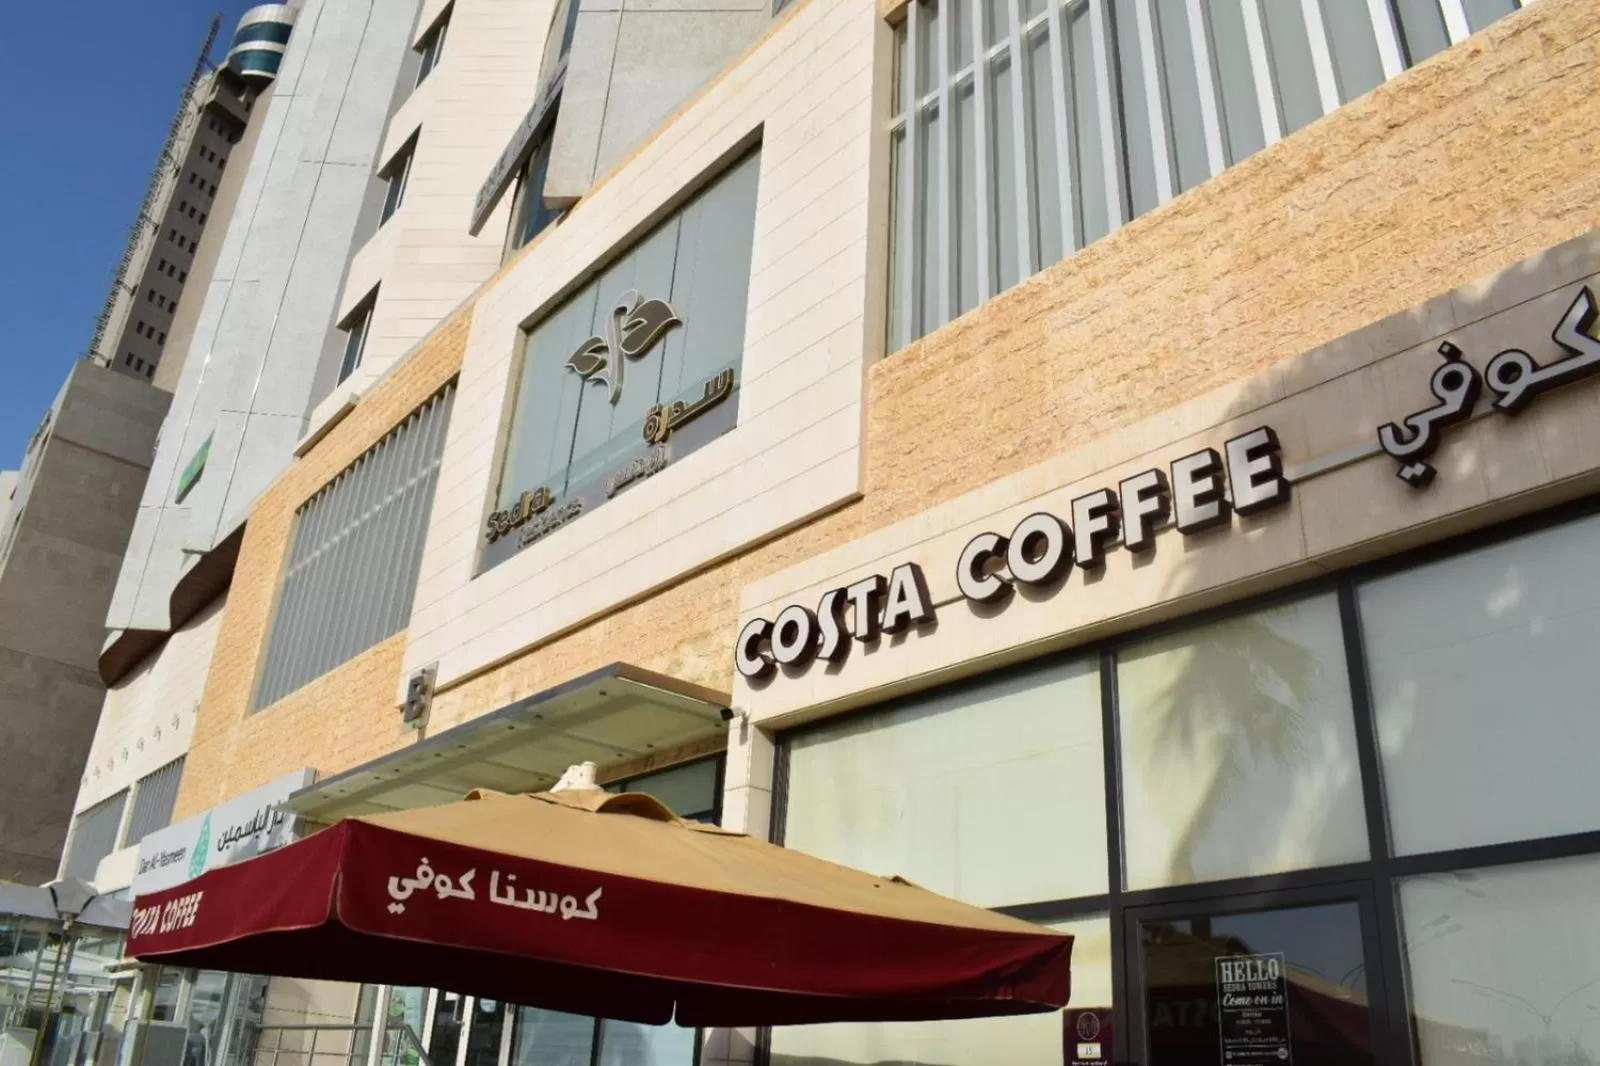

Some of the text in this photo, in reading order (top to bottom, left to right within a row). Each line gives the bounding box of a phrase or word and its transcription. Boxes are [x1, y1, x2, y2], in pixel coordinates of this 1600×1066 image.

[735, 425, 1291, 680] COSTA COFFEE
[386, 856, 603, 920] كوستا كوفي
[160, 891, 204, 933] COFFEE
[1220, 958, 1279, 983] HELLO
[1222, 991, 1283, 1007] Come on in
